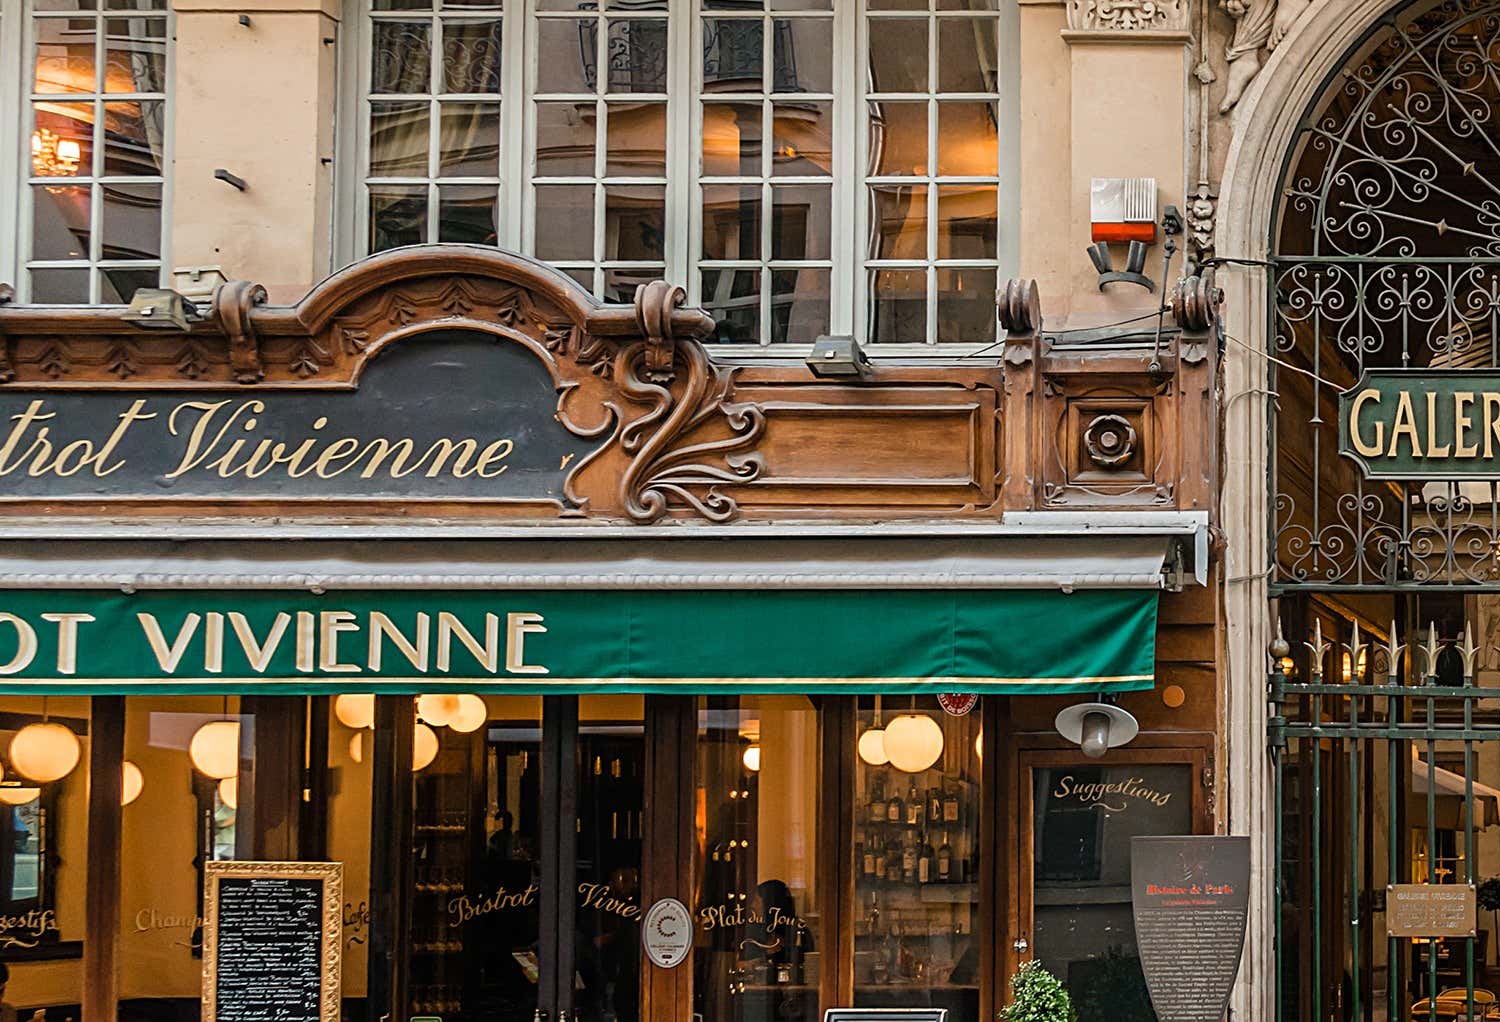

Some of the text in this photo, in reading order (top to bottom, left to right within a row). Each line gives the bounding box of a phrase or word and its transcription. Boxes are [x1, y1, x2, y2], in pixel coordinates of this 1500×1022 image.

[165, 399, 514, 480] Vivienne
[137, 611, 549, 674] VIVIENNE
[1054, 775, 1172, 806] Suggestions
[448, 884, 539, 928] Bistrot
[701, 903, 745, 931] Plat
[748, 911, 764, 924] du
